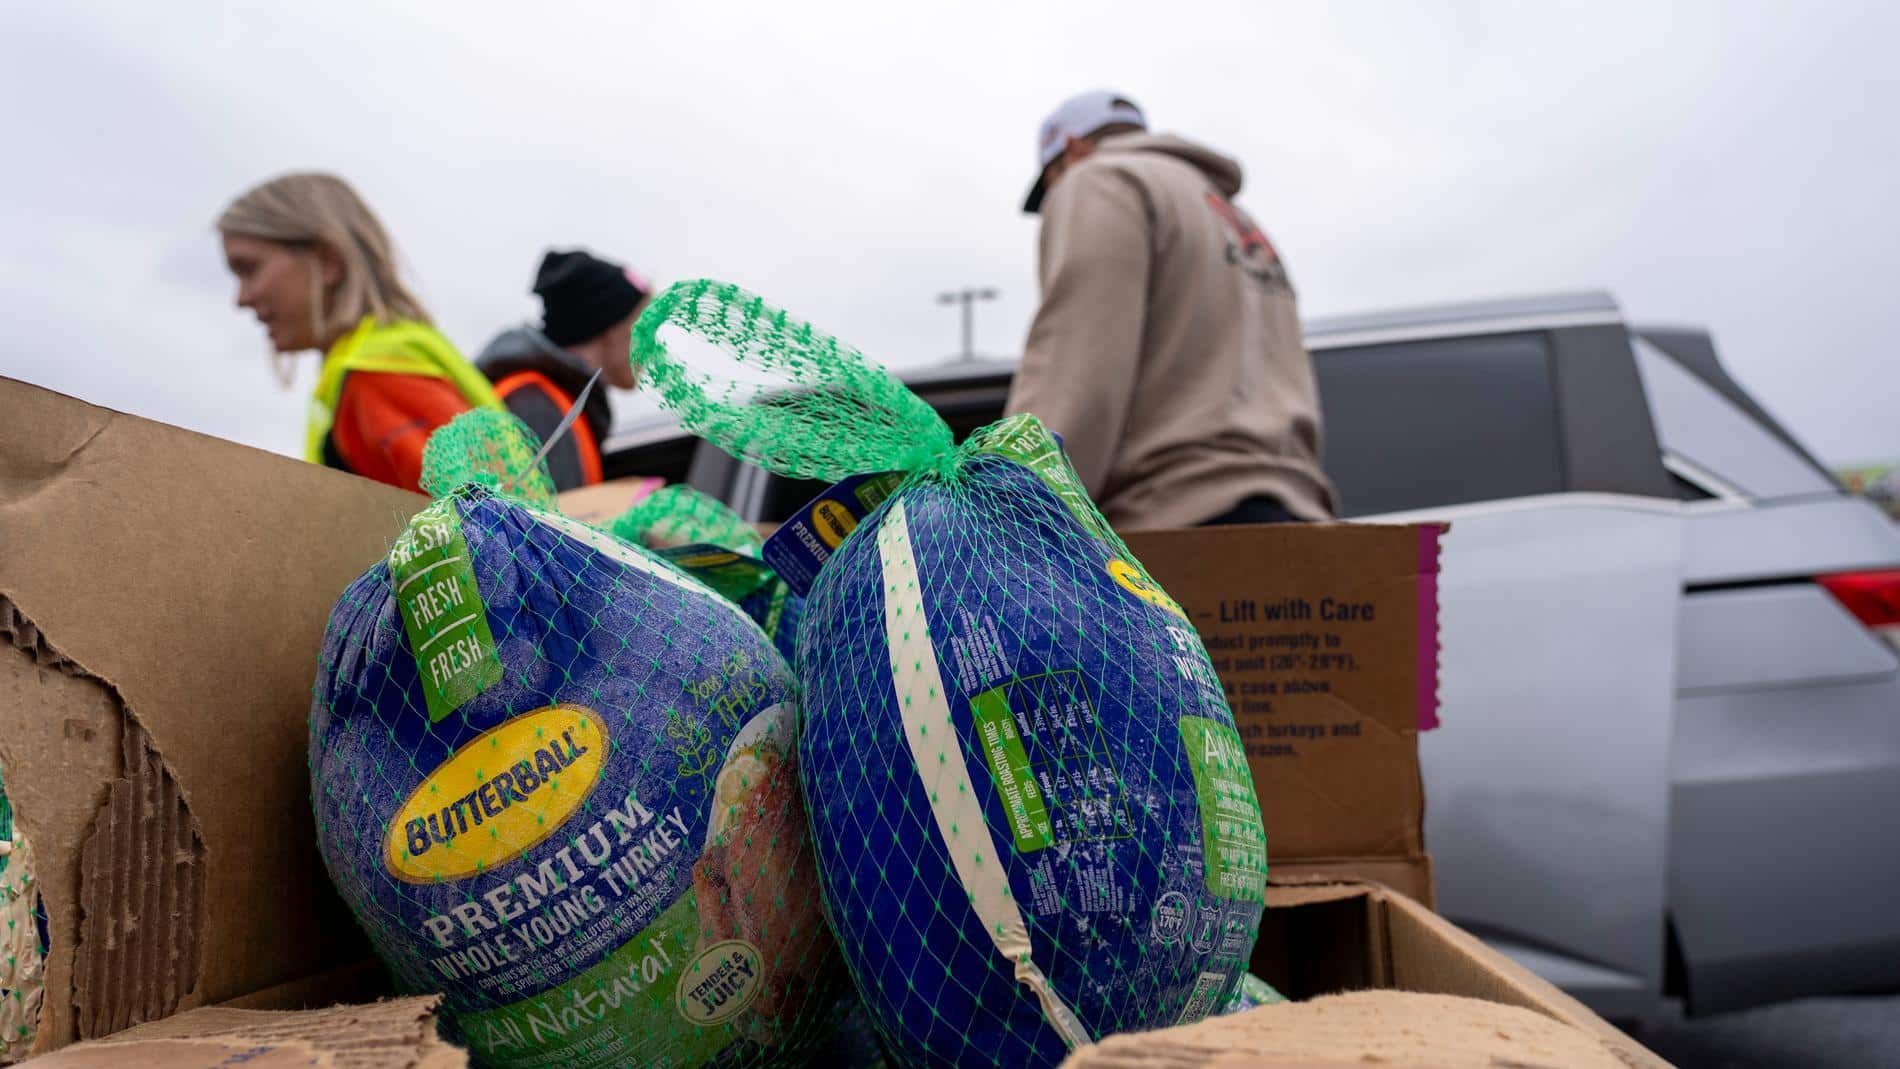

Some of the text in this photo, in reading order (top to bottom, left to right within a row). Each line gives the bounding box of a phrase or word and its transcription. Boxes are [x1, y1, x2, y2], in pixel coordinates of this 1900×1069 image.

[391, 524, 451, 566] FRESH
[790, 520, 830, 563] PREMIU
[411, 575, 464, 630] FRESH
[1219, 599, 1257, 623] Lift
[1264, 597, 1312, 621] with
[1319, 597, 1376, 622] Care
[429, 634, 483, 688] FRESH
[1248, 633, 1320, 651] promptly
[1324, 632, 1342, 647] to
[983, 721, 1001, 747] TIMES
[1331, 721, 1362, 737] and
[991, 745, 1015, 786] ROASTING
[404, 730, 588, 857] BUTTERBALL
[422, 796, 654, 949] PREMIUM
[430, 806, 689, 982] WHOLE YOUNG TURKEY
[688, 960, 734, 1002] TENDER
[701, 959, 754, 1016] JUICY
